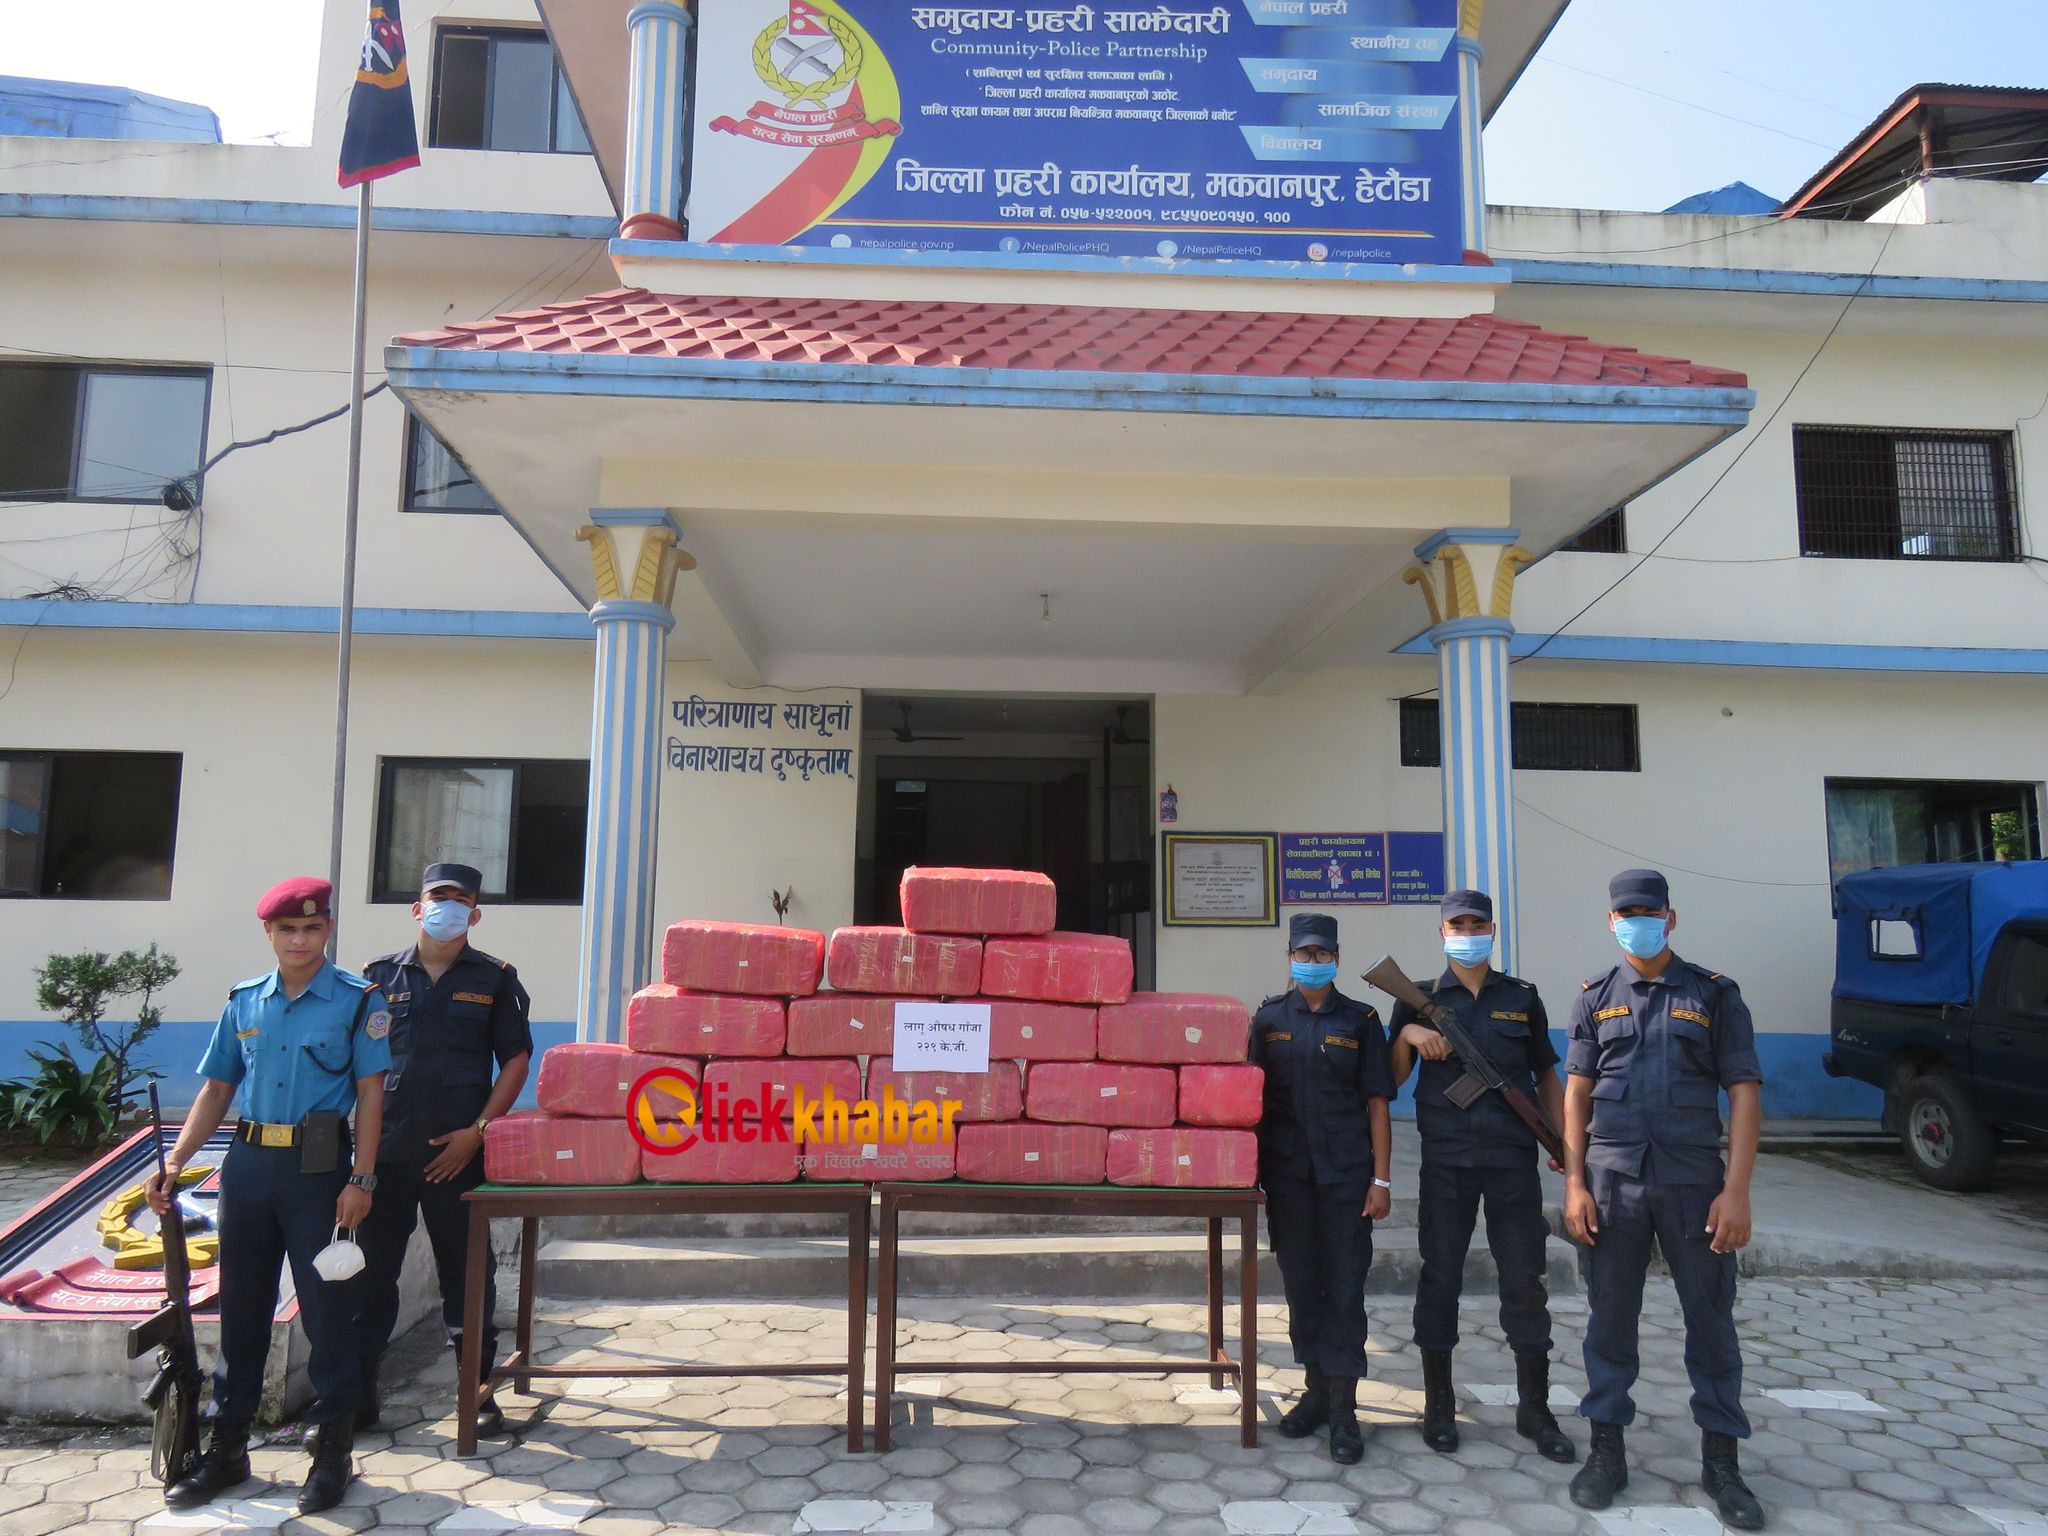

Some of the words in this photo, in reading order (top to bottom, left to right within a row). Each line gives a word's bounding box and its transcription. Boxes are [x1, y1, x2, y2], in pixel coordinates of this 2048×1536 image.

[911, 5, 1095, 35] समुदाय-प्रहरी
[1103, 6, 1231, 35] साझेदारी
[931, 37, 1100, 60] Community-Police
[1106, 41, 1208, 63] Partnership
[1350, 35, 1410, 51] स्थानीय
[1018, 86, 1042, 99] प्रहरी
[1044, 87, 1086, 100] कार्यालय
[895, 157, 986, 194] जिल्ला
[993, 161, 1062, 198] प्रहरी
[1070, 164, 1196, 199] कार्यालय,
[1205, 172, 1346, 208] मकवानपुर,
[999, 203, 1035, 218] फोन
[860, 238, 954, 249] nepalpolice.gov.np
[672, 695, 777, 729] परित्राणाय
[783, 701, 853, 737] साधूनां
[903, 1022, 926, 1036] लागू
[928, 1020, 957, 1032] औषध
[917, 1042, 937, 1052] २२९
